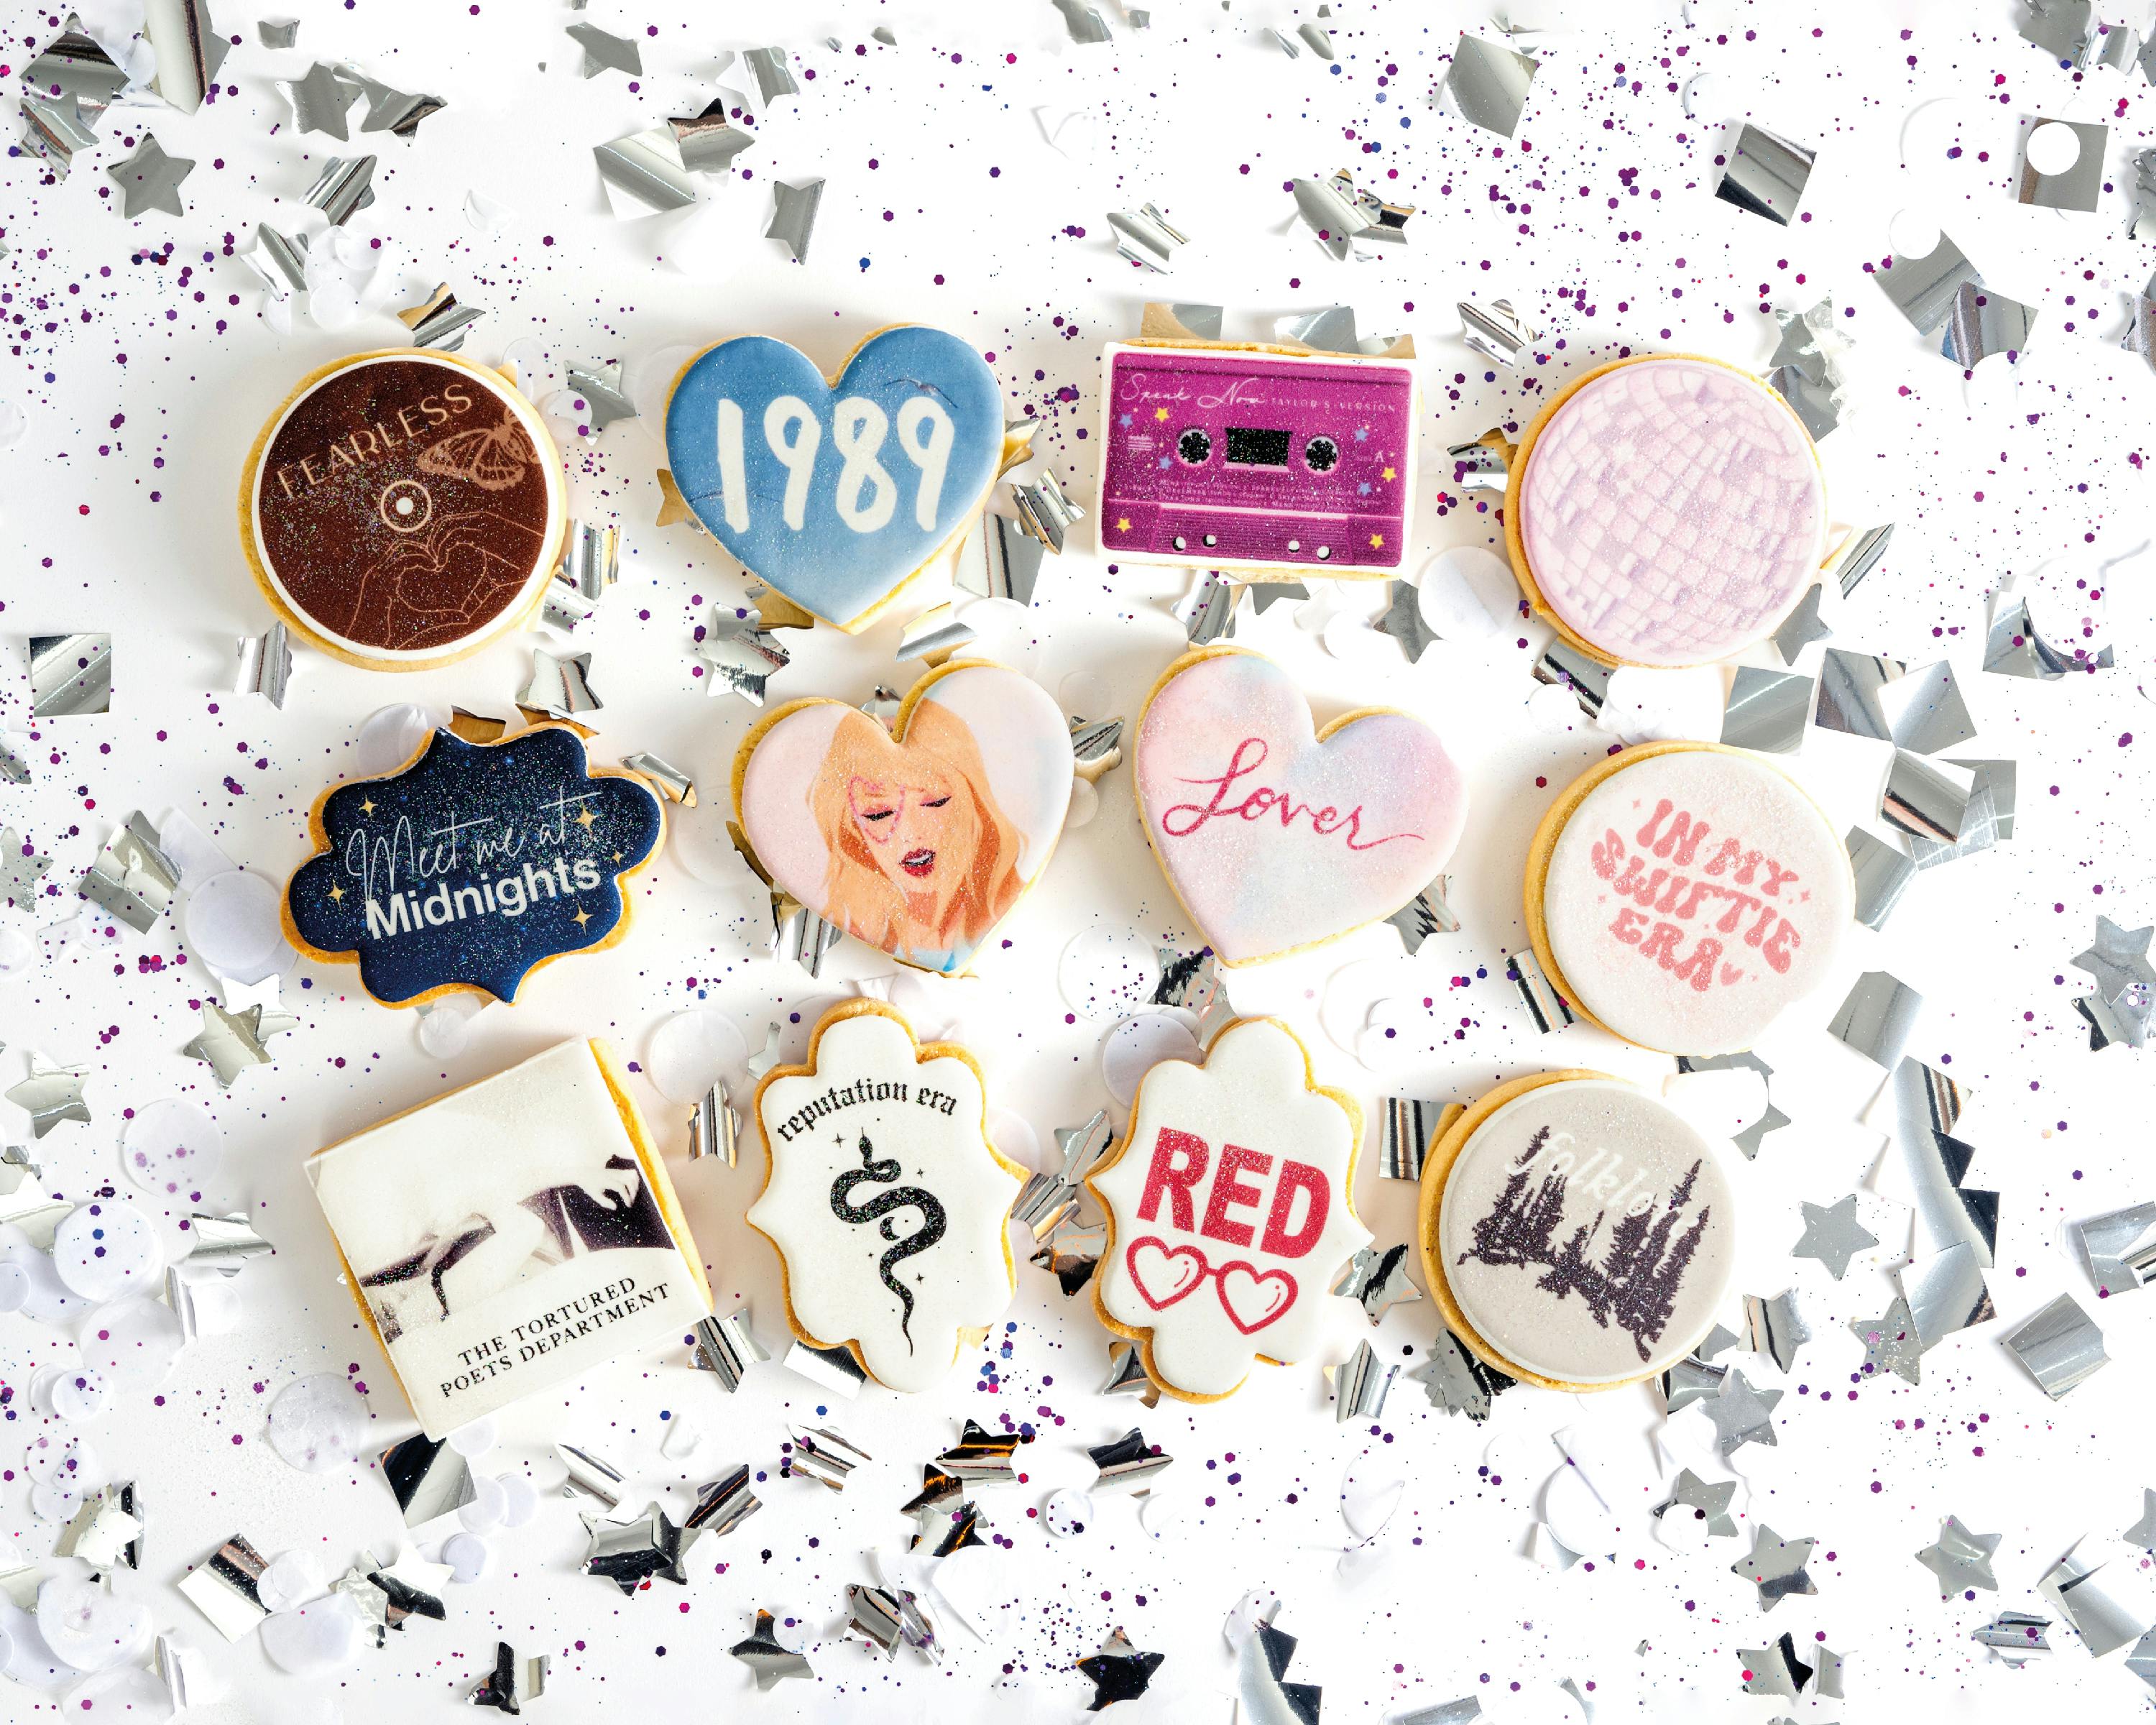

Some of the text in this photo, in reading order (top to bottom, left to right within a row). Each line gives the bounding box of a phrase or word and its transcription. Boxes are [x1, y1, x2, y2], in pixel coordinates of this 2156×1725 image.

[277, 385, 471, 496] FEARLESS
[1120, 373, 1192, 404] Speak
[1197, 378, 1266, 408] Now
[718, 395, 954, 533] 1989
[346, 786, 603, 901] Meet me at
[1163, 737, 1425, 850] Lover
[1636, 799, 1800, 897] IN MY
[367, 857, 601, 940] Midnights
[1591, 828, 1801, 975] SWIFTIE
[1608, 908, 1723, 993] ERA
[778, 1078, 957, 1142] reputation era
[1136, 1126, 1331, 1259] RED
[440, 1282, 670, 1398] POETS DEPARTMENT
[457, 1276, 636, 1366] THE TORTURED
